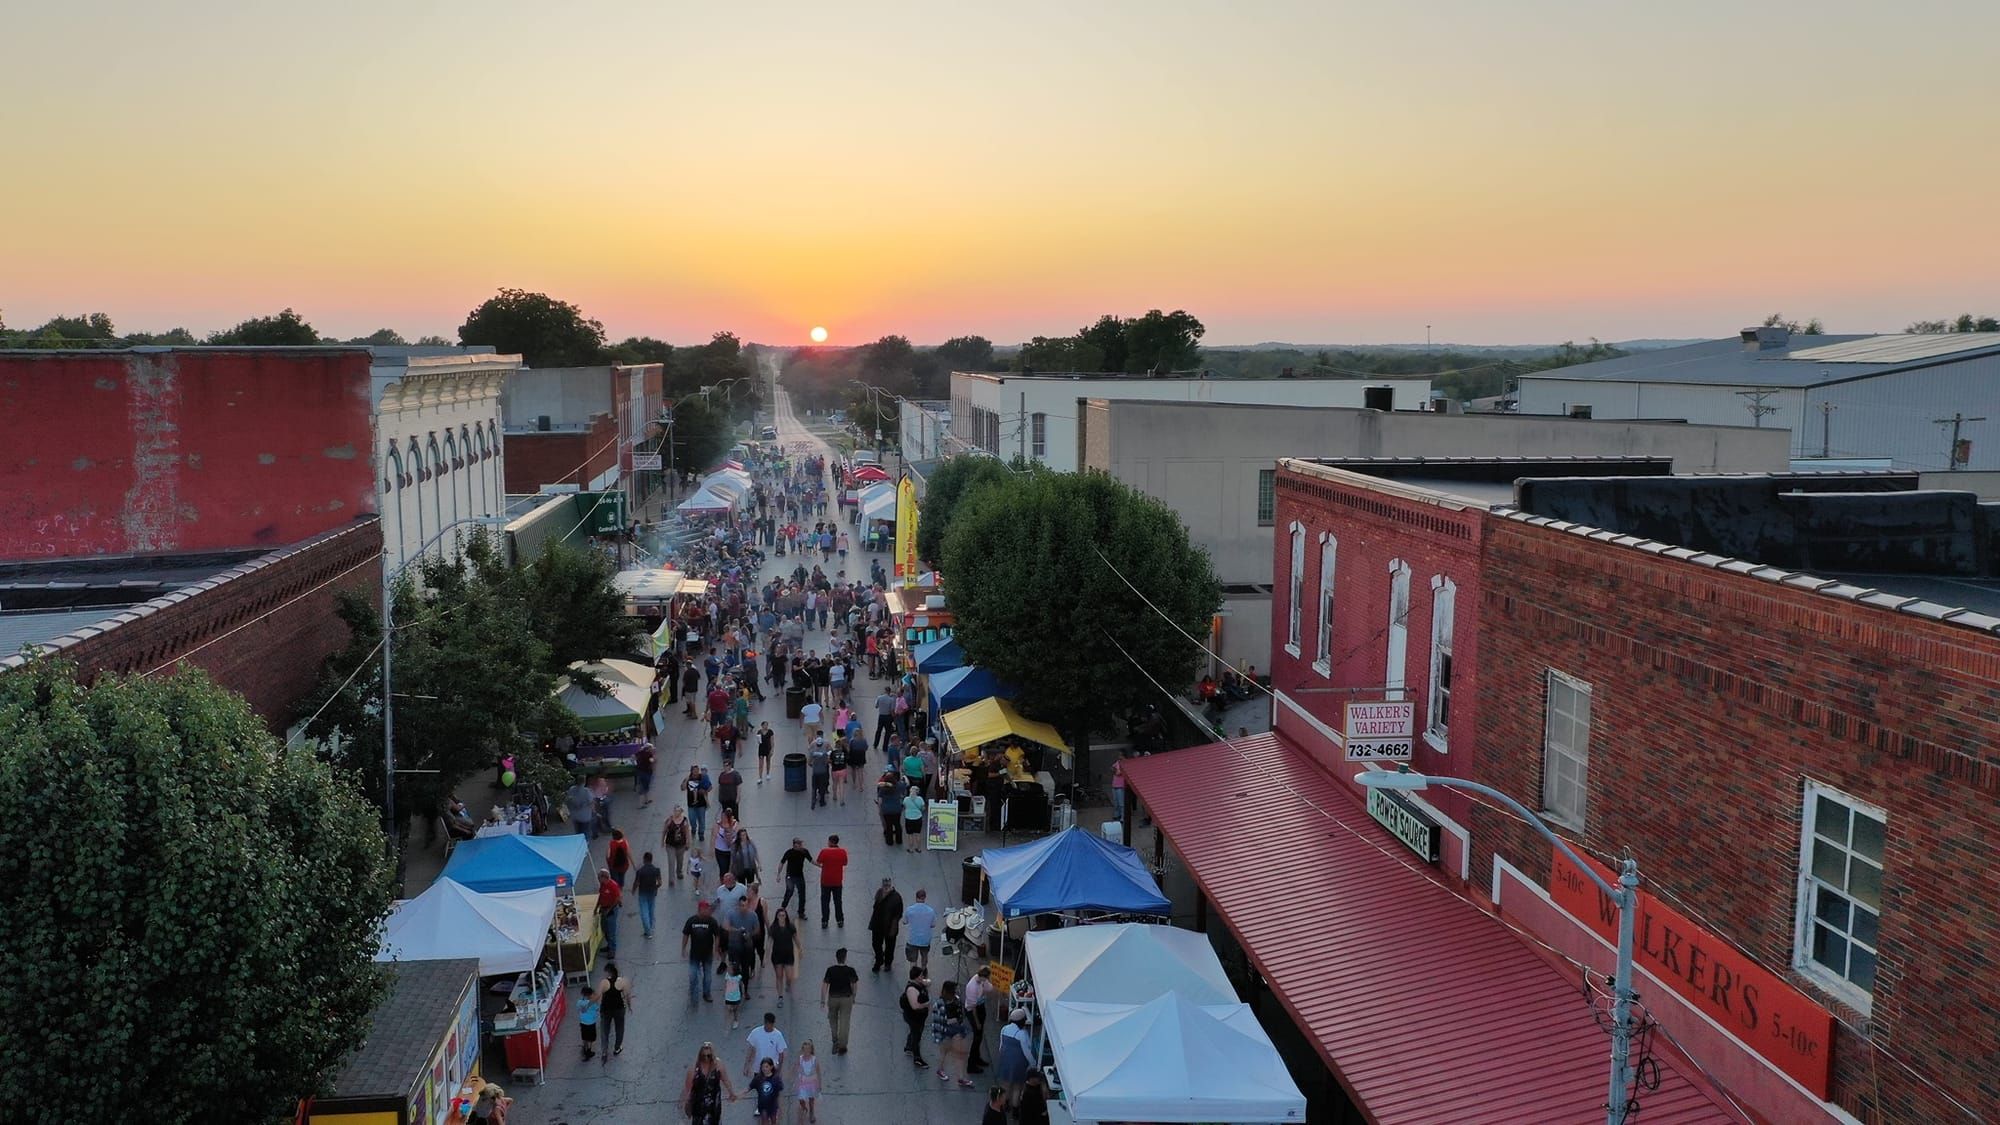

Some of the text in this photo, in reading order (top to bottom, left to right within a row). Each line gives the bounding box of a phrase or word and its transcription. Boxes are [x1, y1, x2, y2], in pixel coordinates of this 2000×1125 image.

[1350, 705, 1410, 719] WALKER'S
[1355, 721, 1406, 734] VARIETY
[1348, 743, 1409, 757] 732-4662
[1376, 793, 1428, 856] POWER SOURCE
[1599, 887, 1759, 1031] WLKER'S
